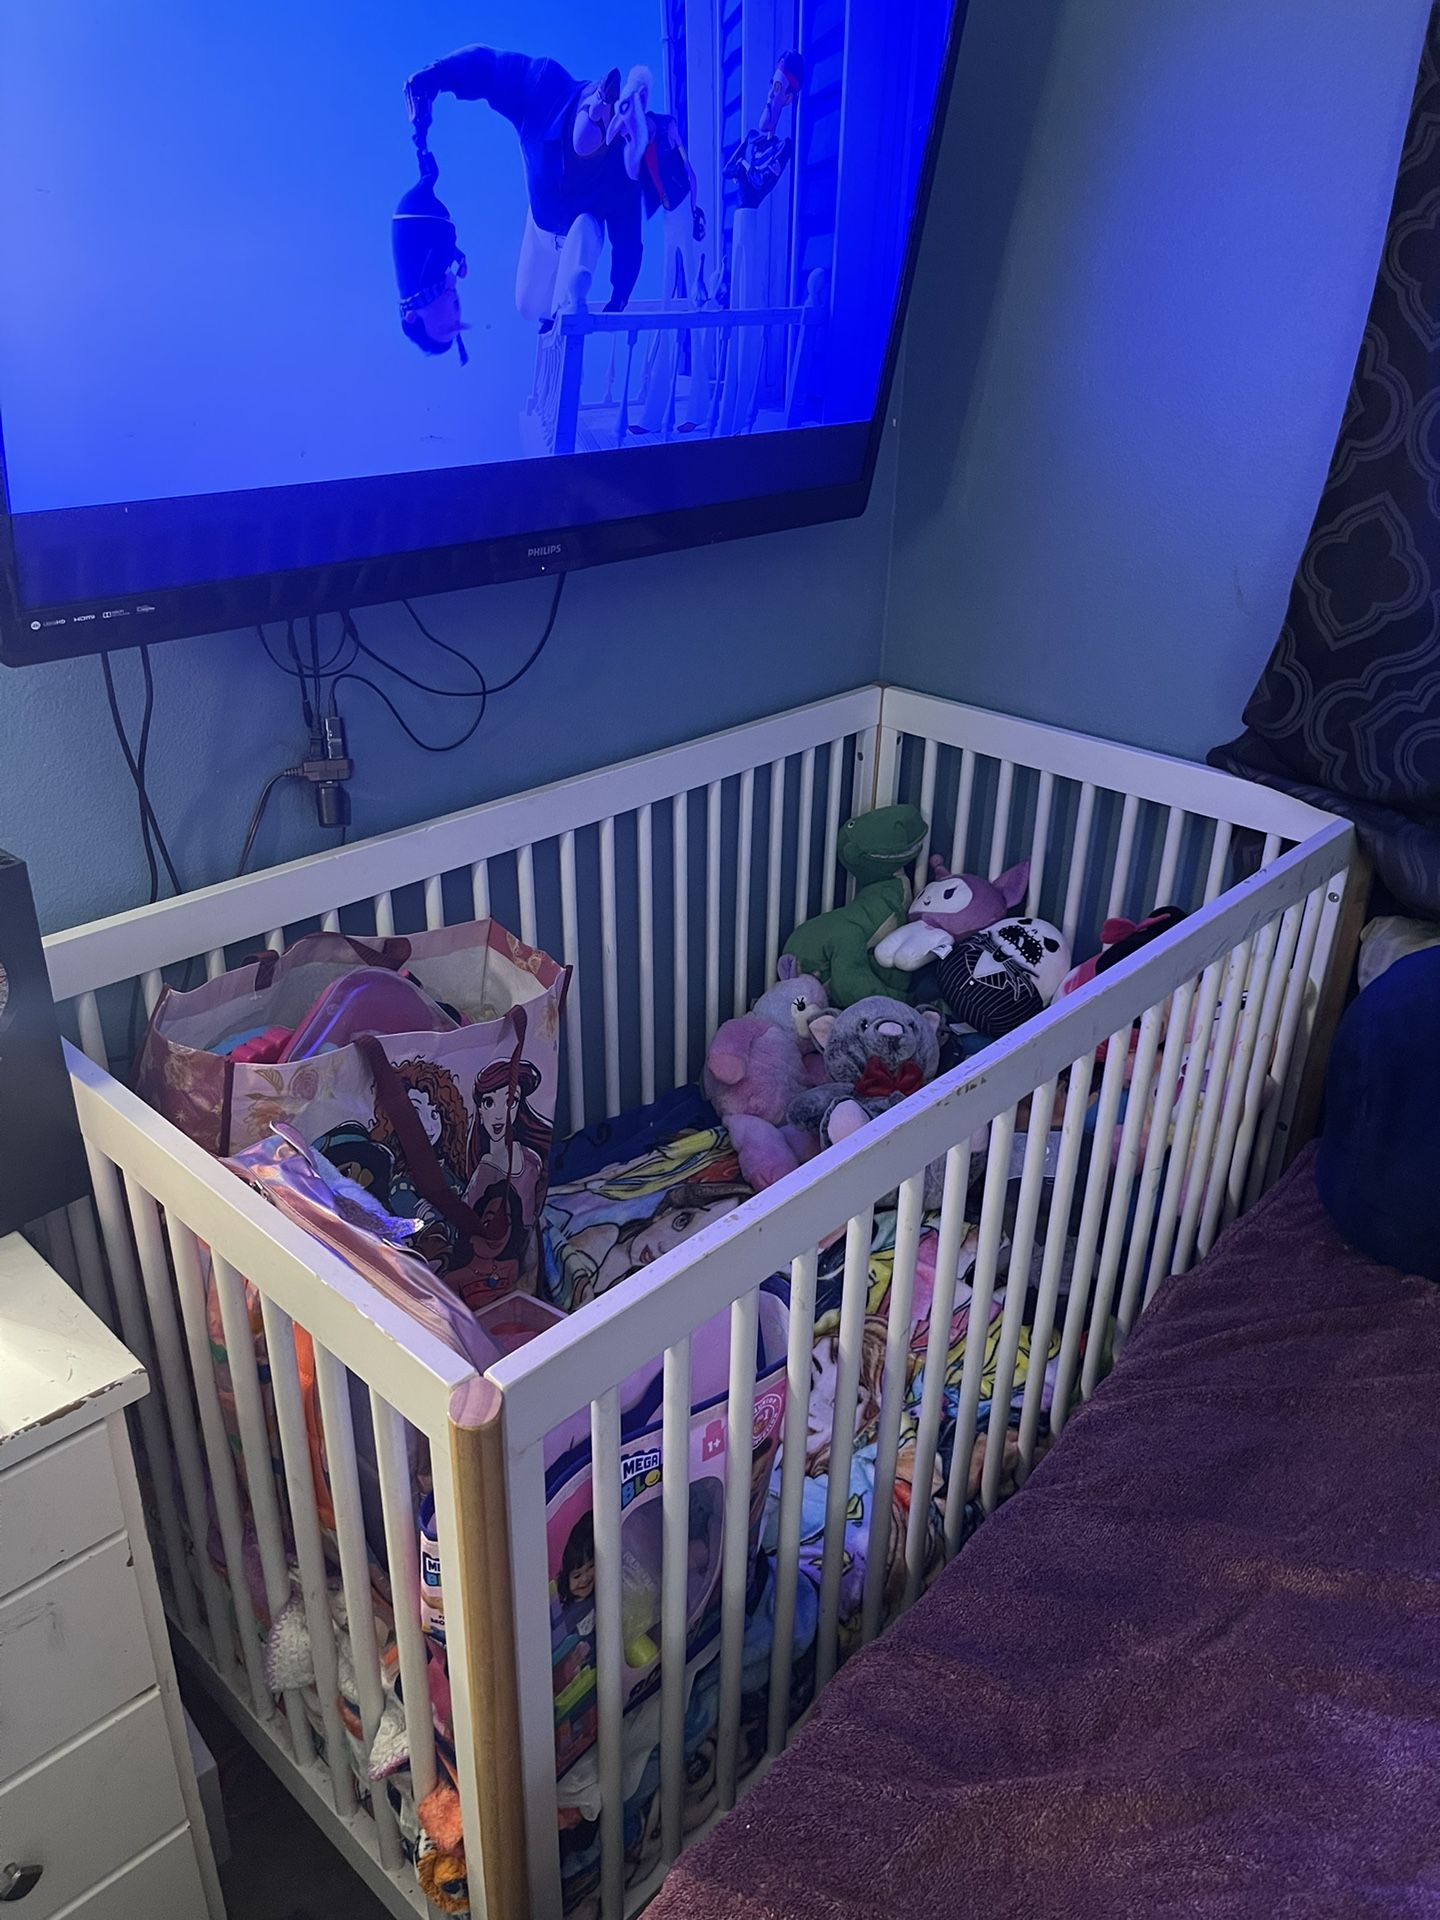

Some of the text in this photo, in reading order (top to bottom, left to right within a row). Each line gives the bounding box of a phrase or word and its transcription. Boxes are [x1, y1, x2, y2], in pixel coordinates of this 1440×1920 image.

[527, 544, 561, 558] PHILIPS
[707, 1438, 721, 1452] 1+
[623, 1454, 659, 1480] MEGA
